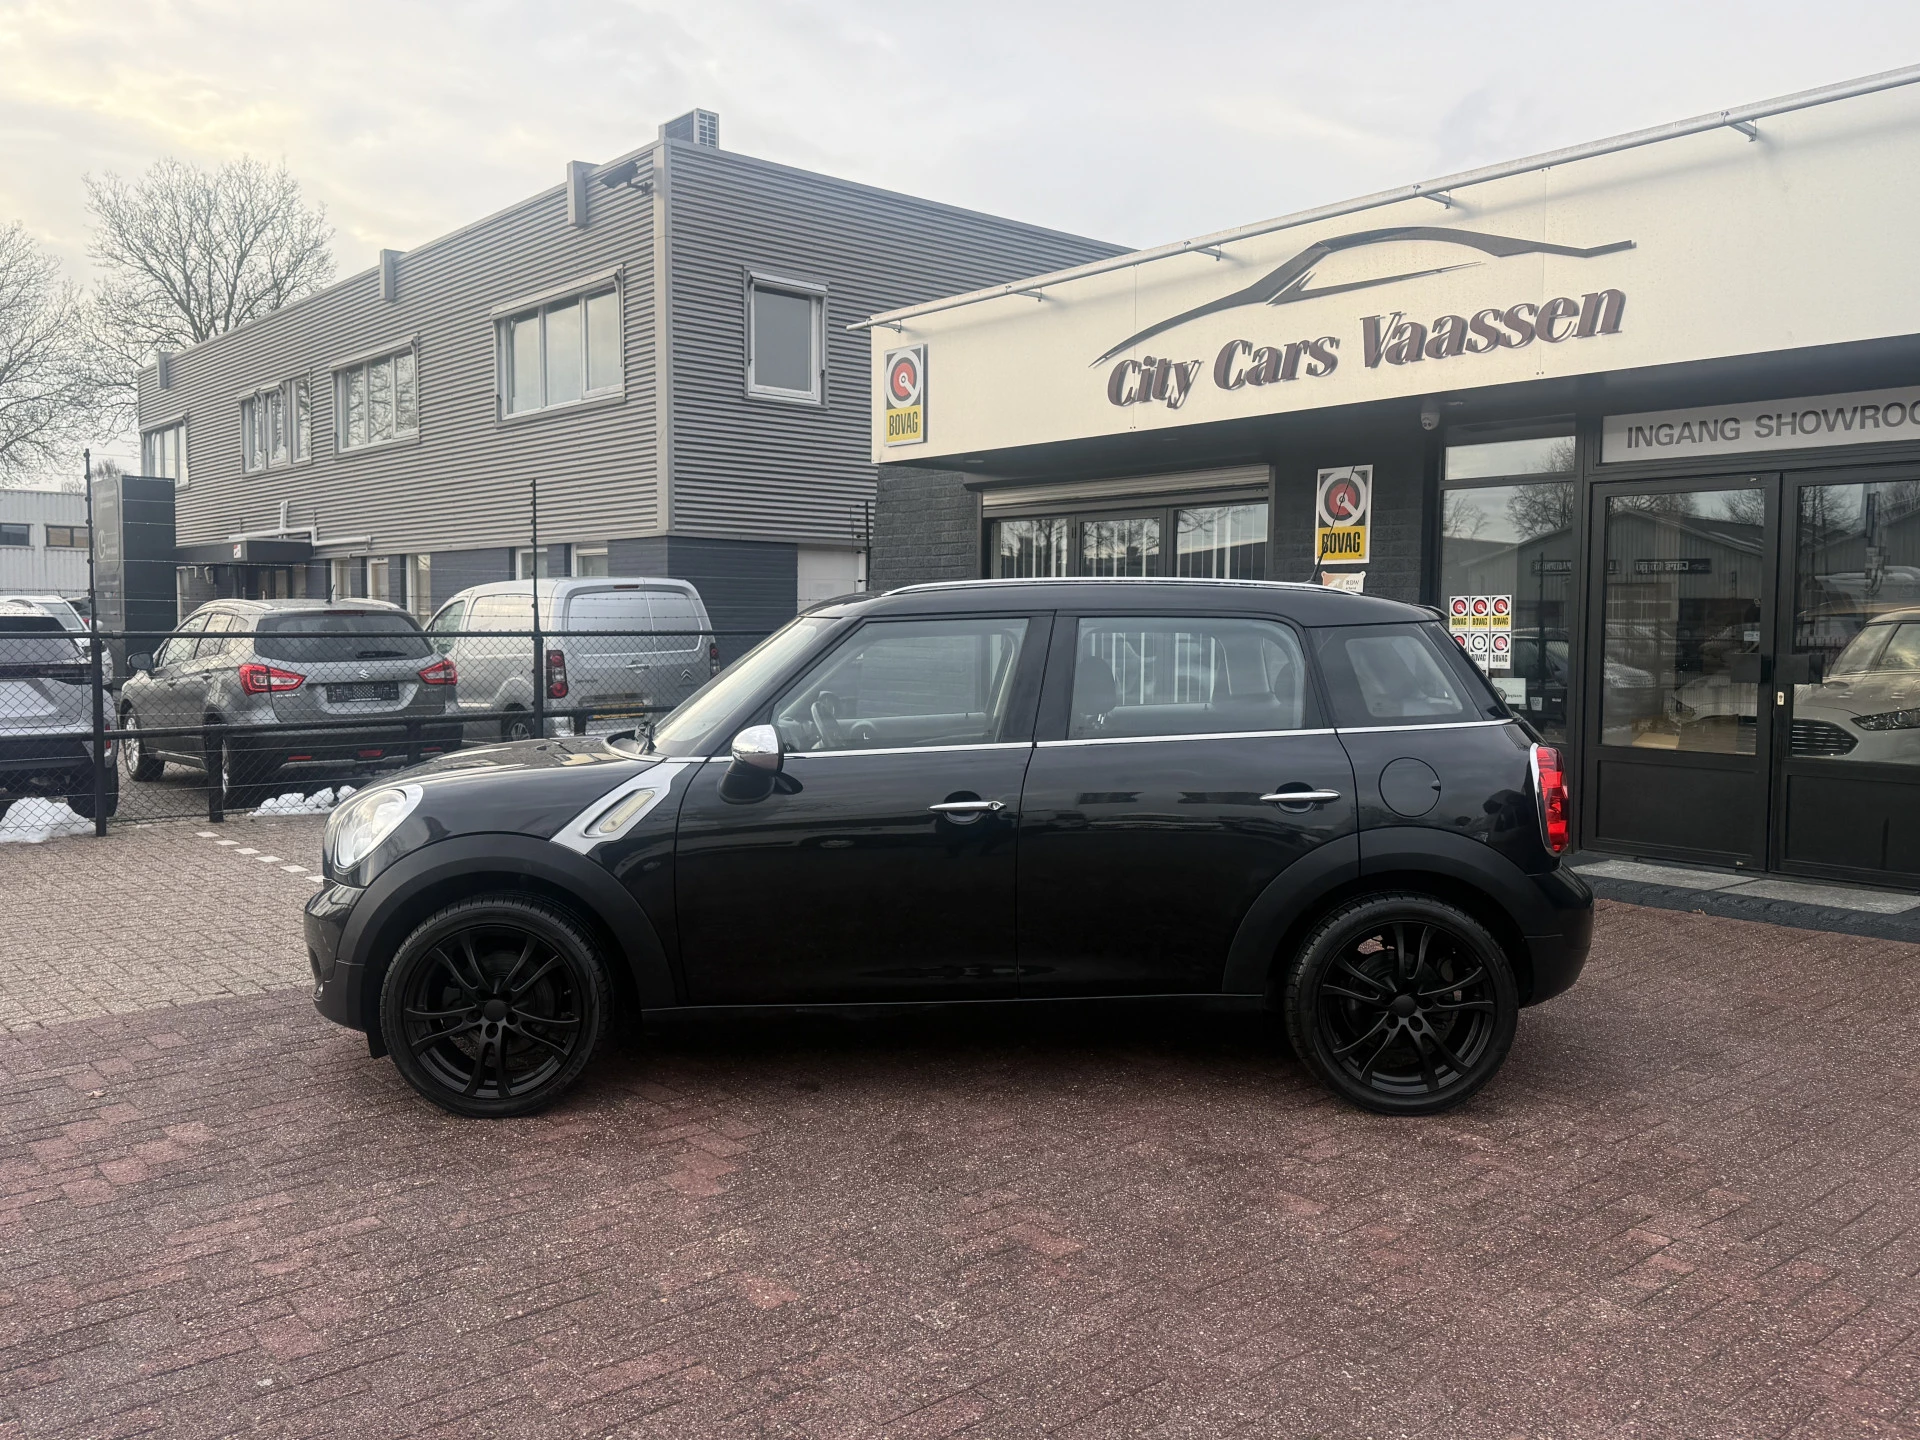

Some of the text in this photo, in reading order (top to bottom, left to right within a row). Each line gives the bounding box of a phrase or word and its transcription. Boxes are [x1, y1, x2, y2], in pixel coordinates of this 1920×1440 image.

[1107, 288, 1626, 409] City Cars Vaassen
[889, 411, 918, 436] BOVAG
[1626, 417, 1741, 449] INGANG
[1321, 531, 1361, 554] BOVAG
